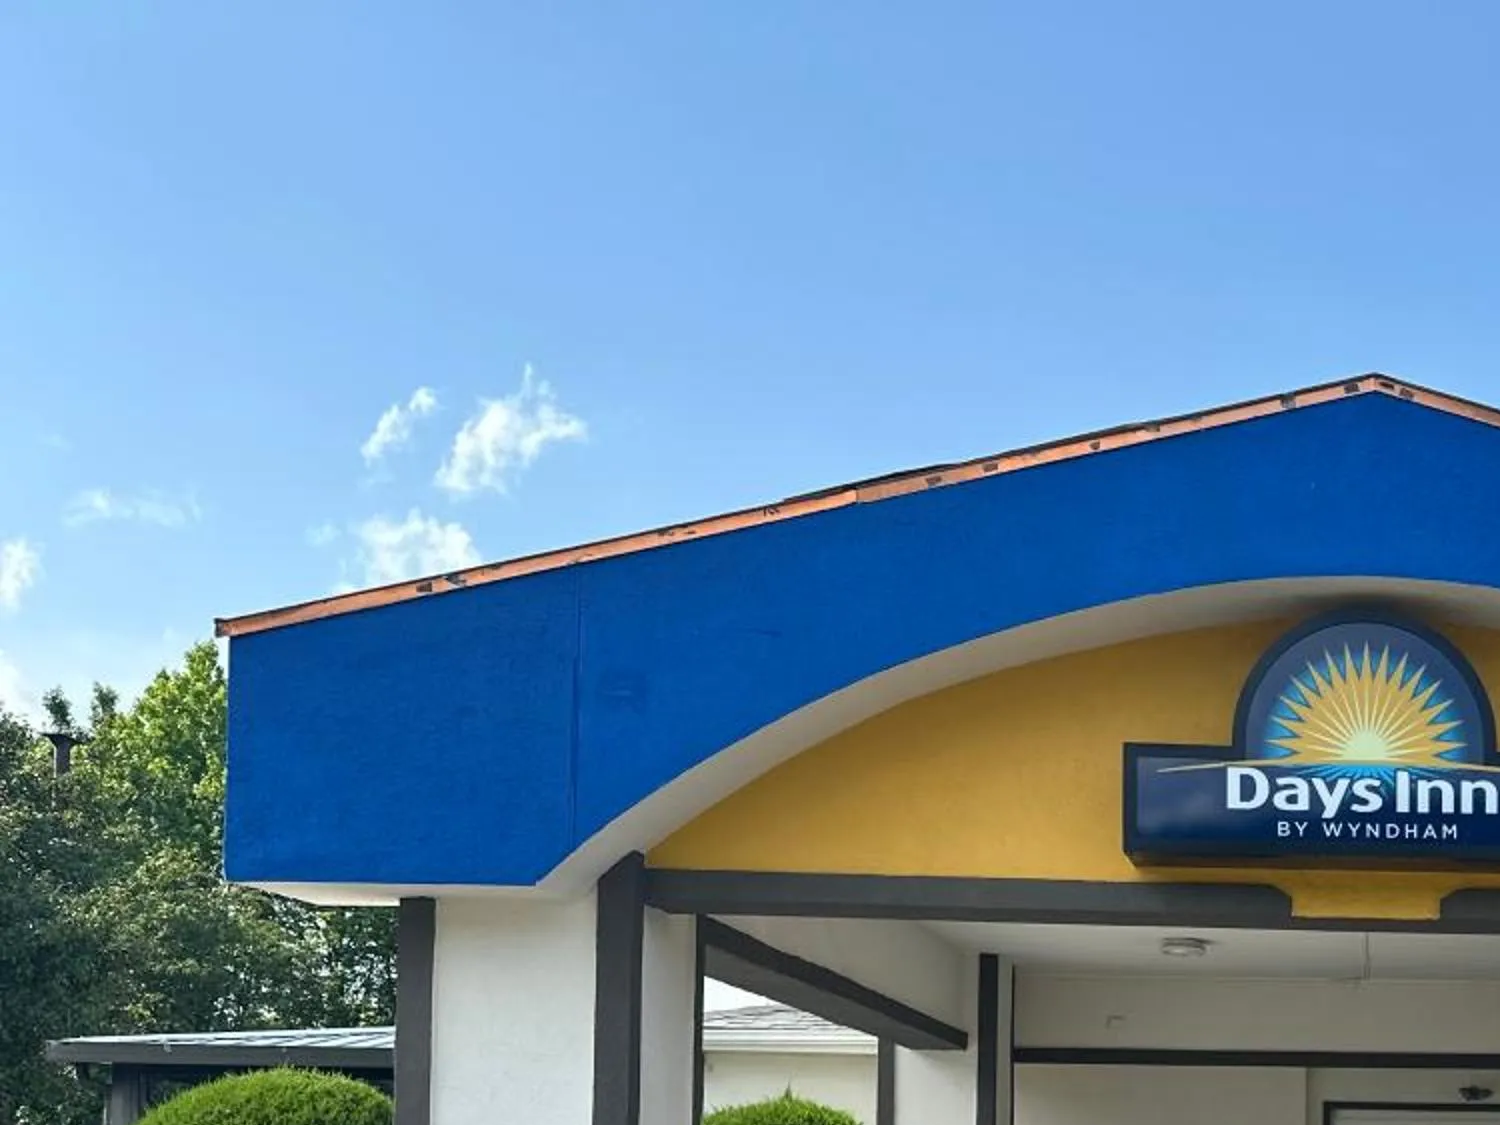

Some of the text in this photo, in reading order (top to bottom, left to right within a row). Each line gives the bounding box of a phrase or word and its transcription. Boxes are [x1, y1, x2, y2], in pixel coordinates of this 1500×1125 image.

[1227, 766, 1499, 819] Days Inn
[1277, 821, 1458, 840] BY WYNDHAM
